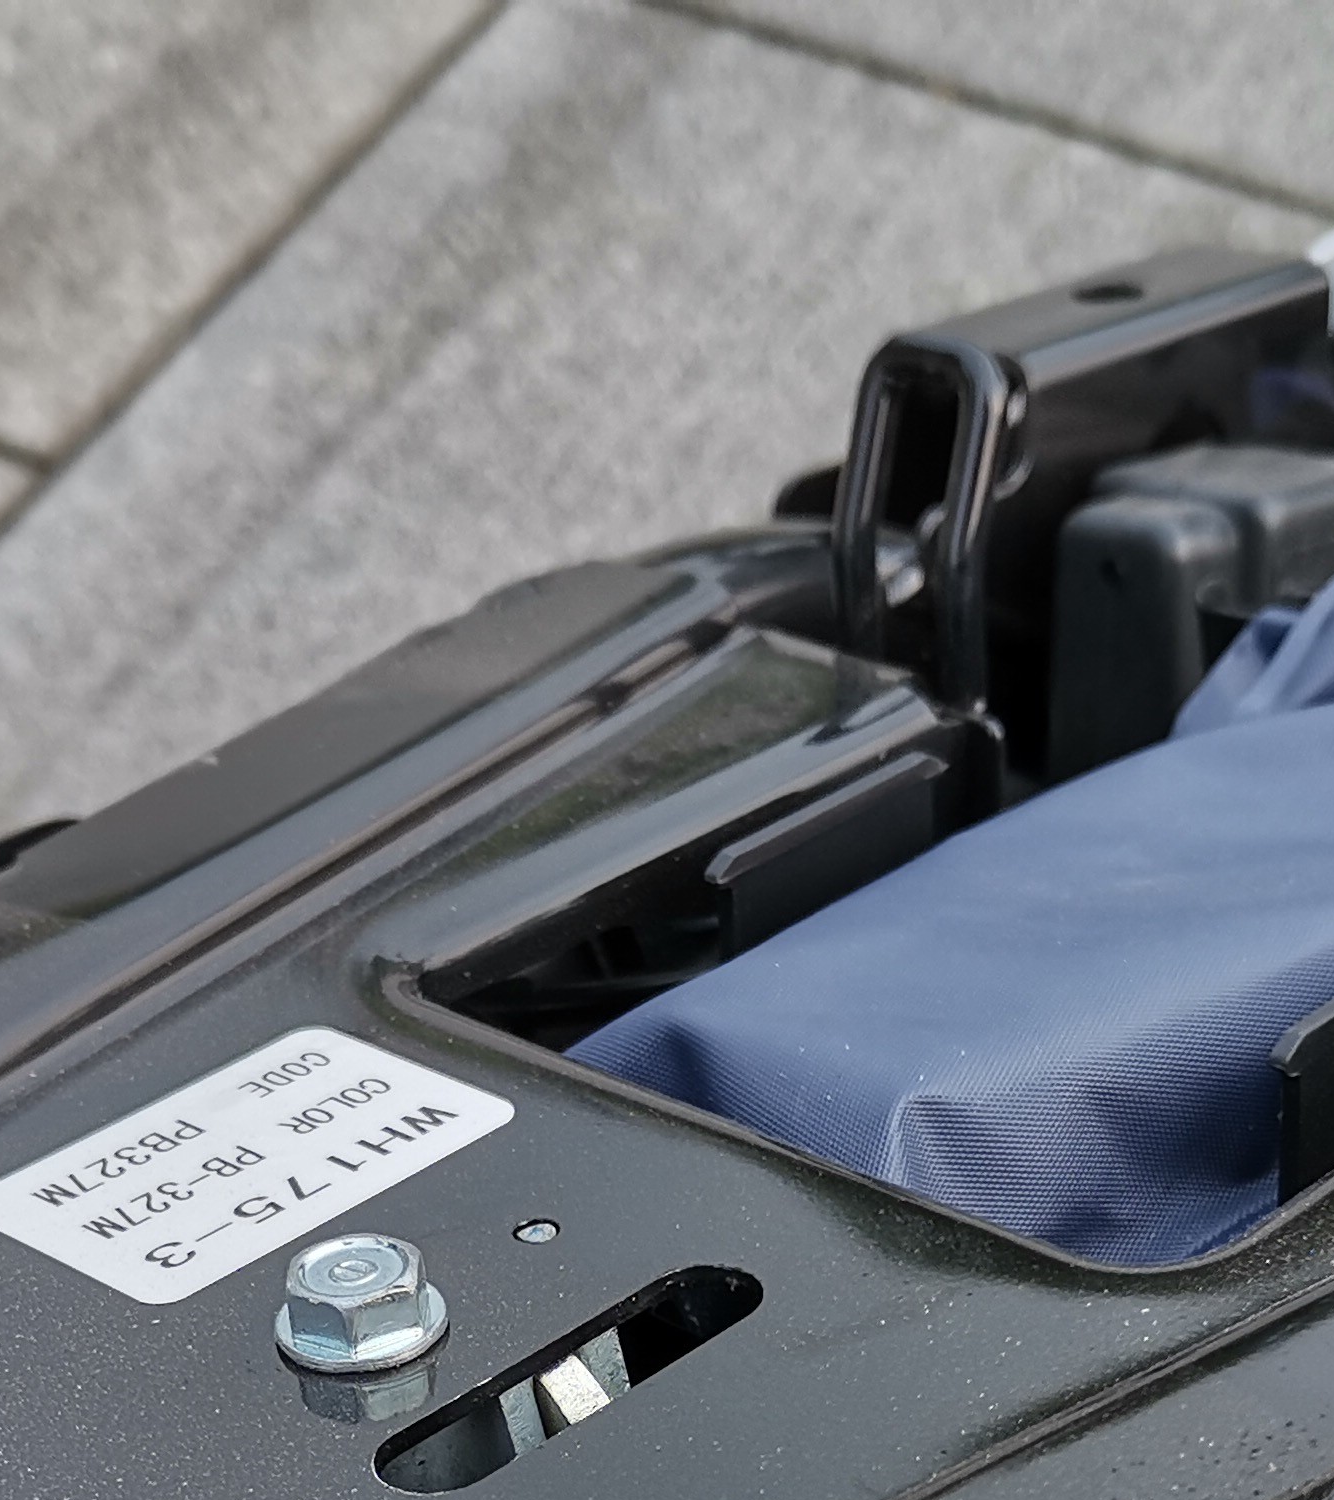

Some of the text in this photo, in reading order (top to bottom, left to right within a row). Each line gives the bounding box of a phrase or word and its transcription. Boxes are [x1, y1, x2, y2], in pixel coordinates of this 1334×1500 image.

[30, 1052, 331, 1207] CODE PB327M
[82, 1078, 391, 1239] COLOR PB-327M
